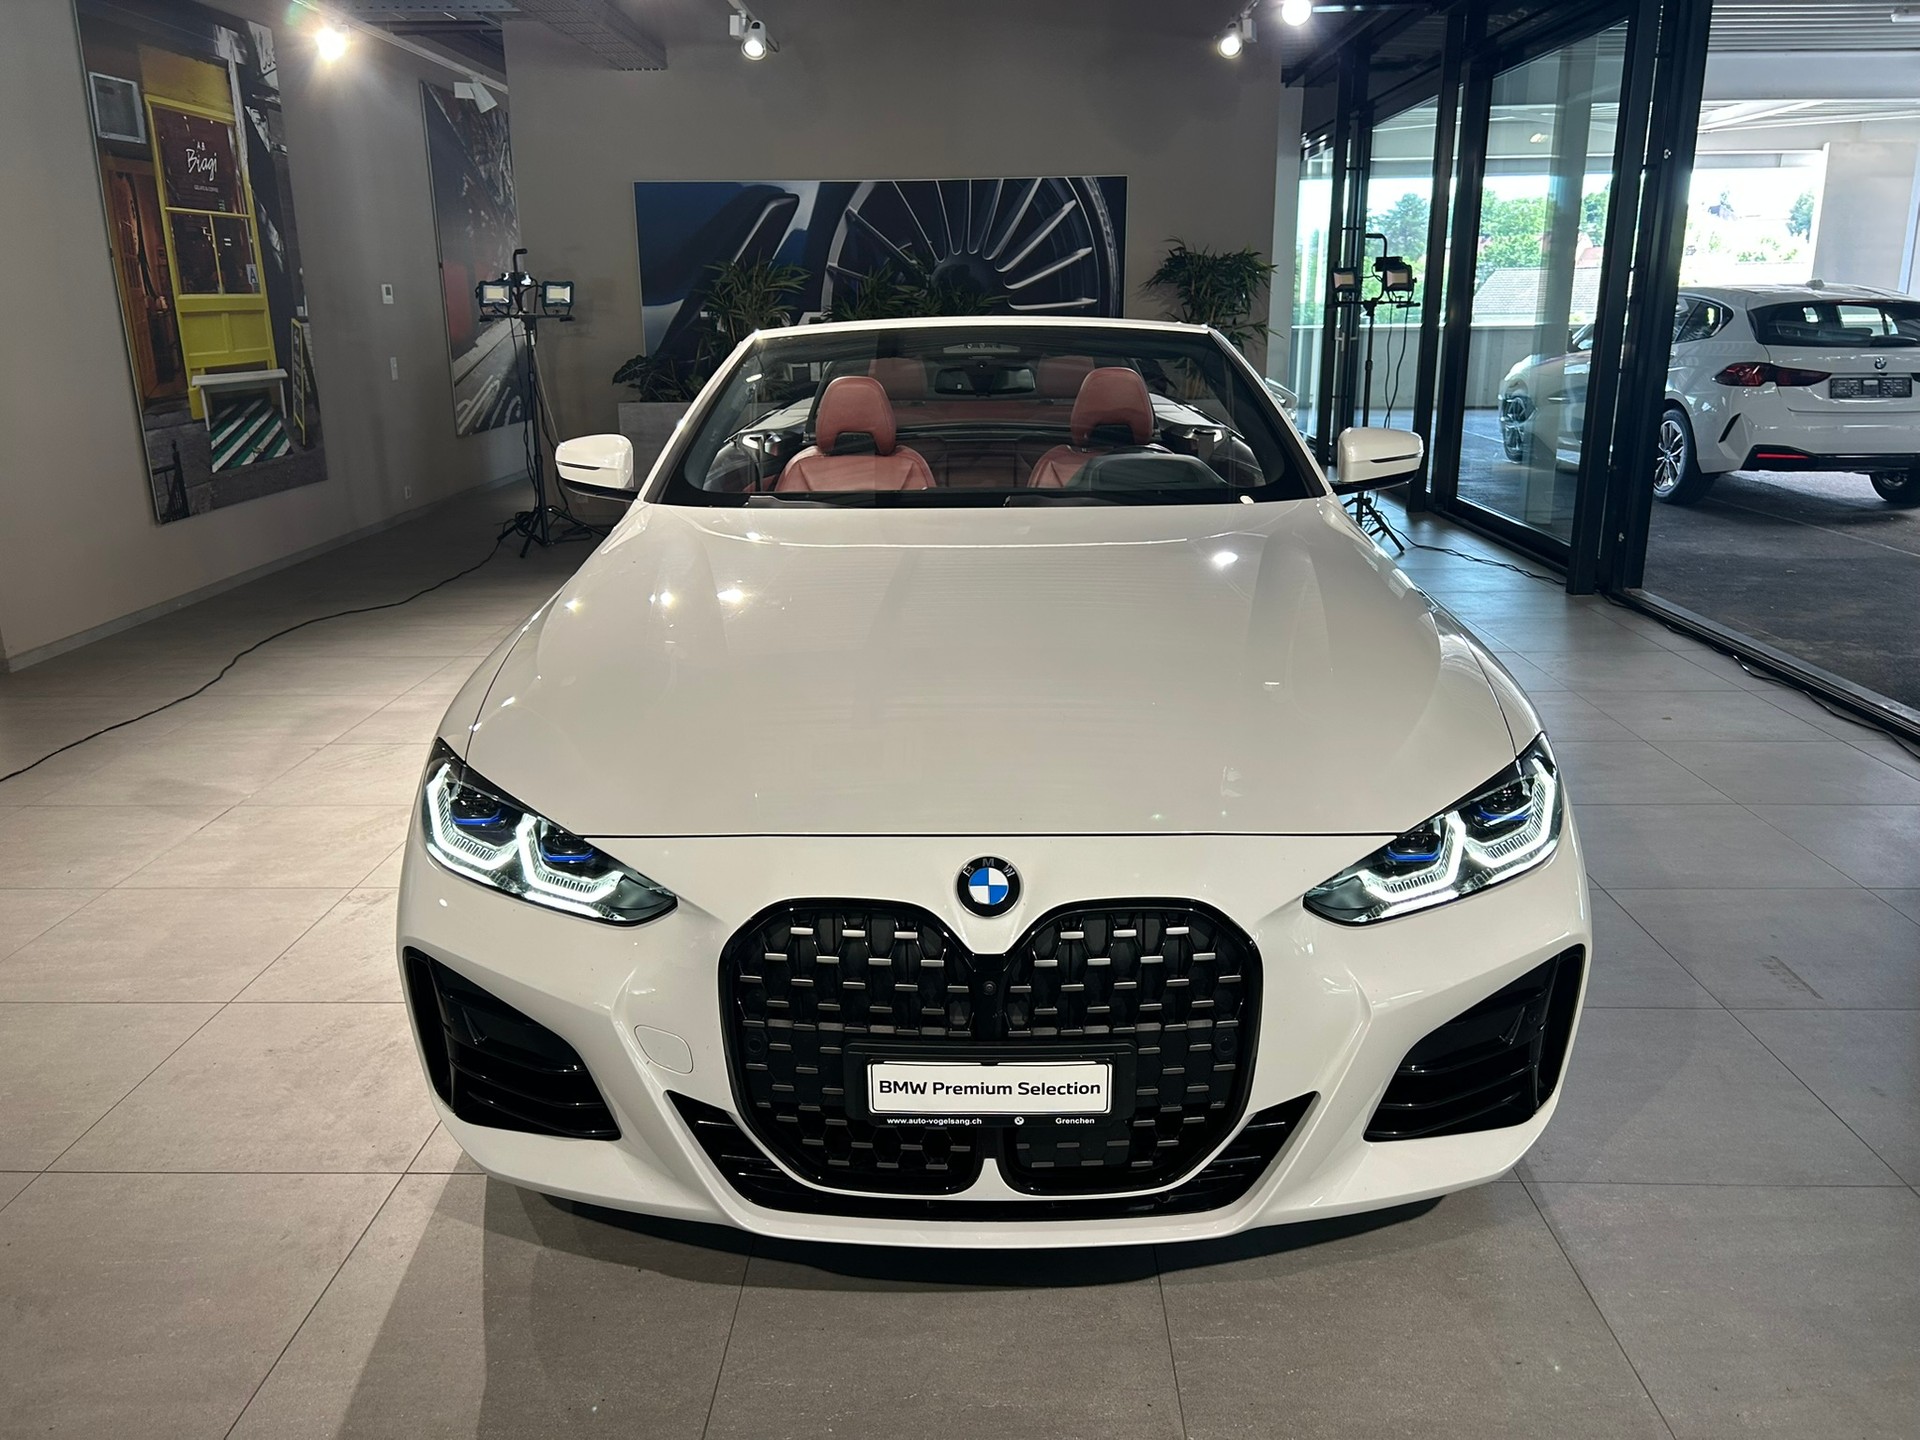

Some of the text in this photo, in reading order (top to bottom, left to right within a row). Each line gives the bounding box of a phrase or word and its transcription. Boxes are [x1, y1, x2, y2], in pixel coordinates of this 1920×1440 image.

[186, 148, 217, 181] Biagi
[962, 858, 1016, 877] BMW
[879, 1080, 1101, 1095] BMW Premium Selection
[886, 1116, 1095, 1127] www.auto-vogelsang.ch Grenchen
